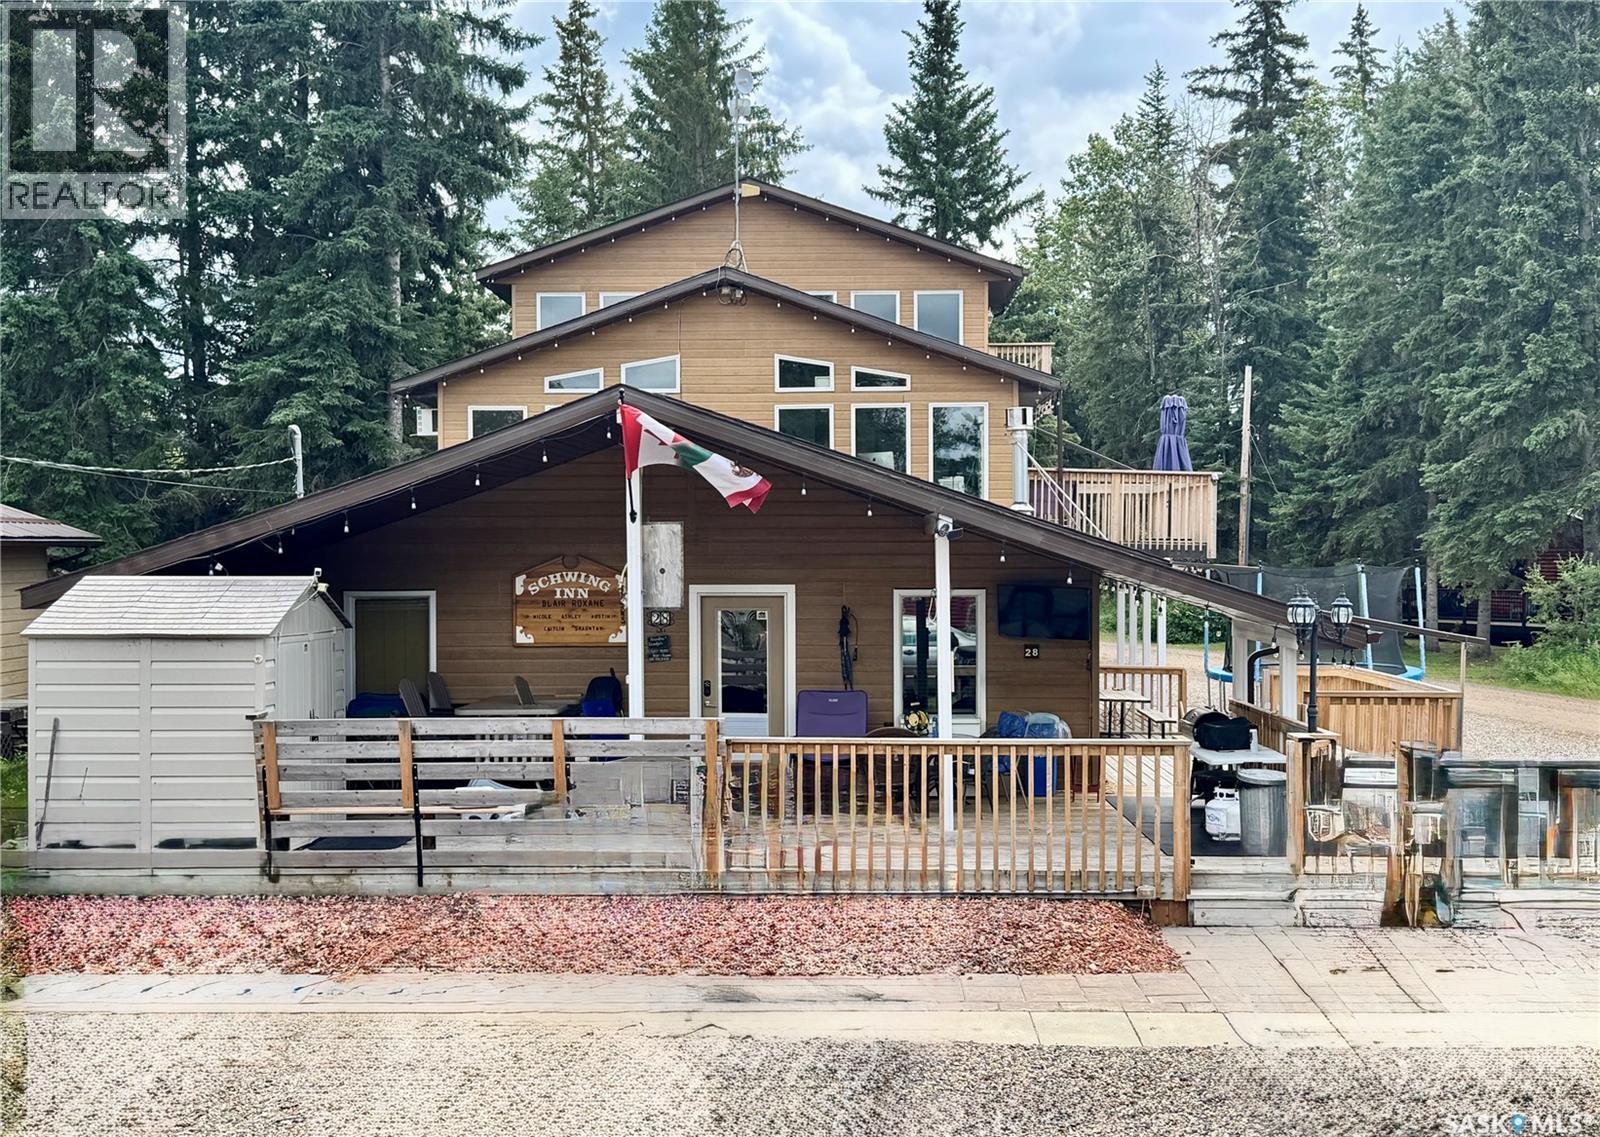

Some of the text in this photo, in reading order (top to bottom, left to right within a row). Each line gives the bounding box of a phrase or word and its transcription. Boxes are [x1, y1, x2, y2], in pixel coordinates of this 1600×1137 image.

[528, 571, 611, 595] SCHWING
[554, 587, 589, 599] INN
[541, 599, 605, 608] BLAIR ROXANE
[651, 611, 670, 625] 28
[1024, 648, 1039, 657] 28
